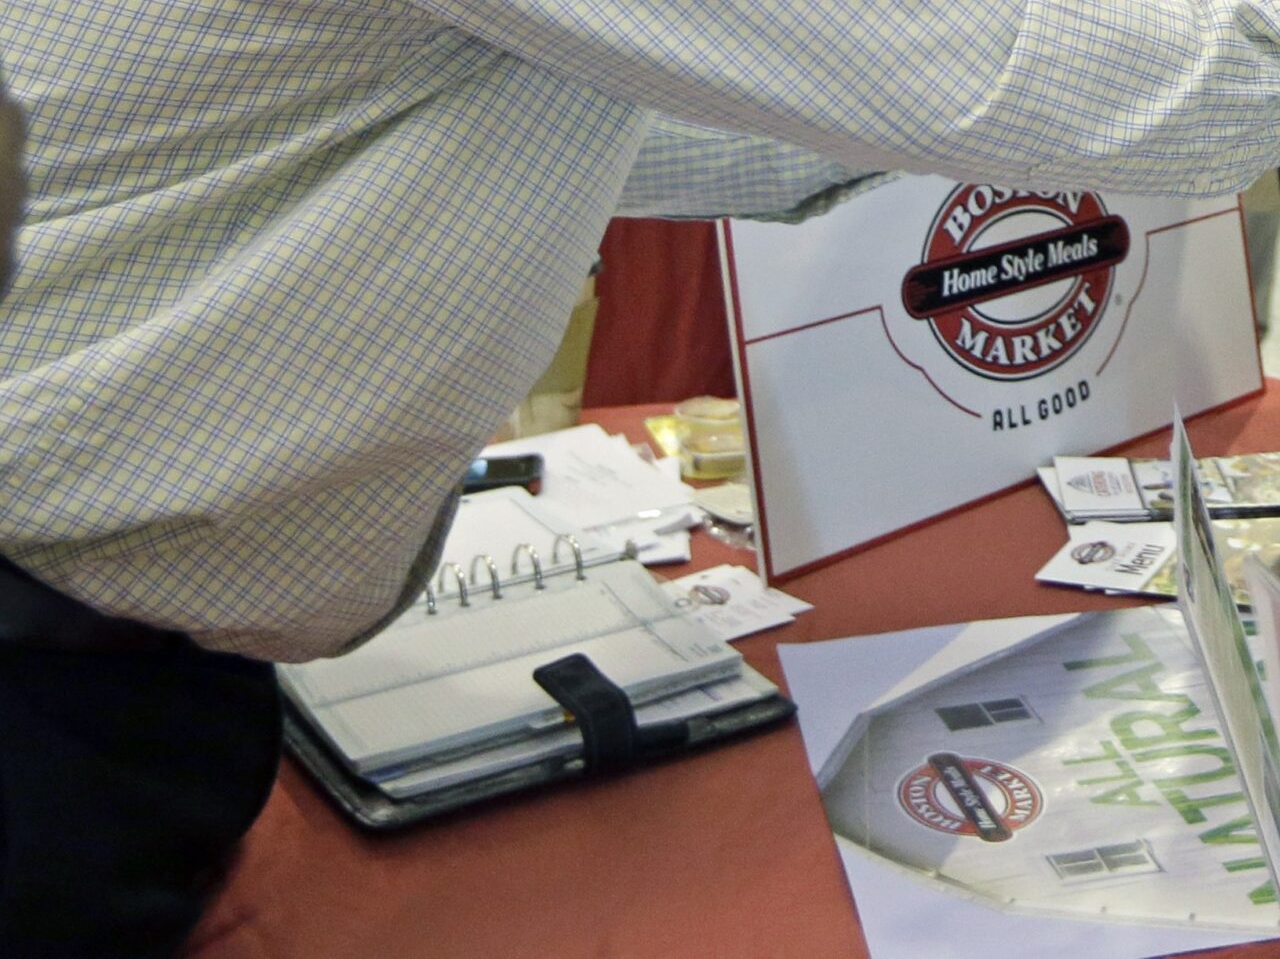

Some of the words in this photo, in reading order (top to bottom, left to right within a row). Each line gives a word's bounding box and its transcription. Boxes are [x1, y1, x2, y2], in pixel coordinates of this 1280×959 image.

[942, 264, 998, 297] Home
[1001, 248, 1045, 281] Style
[1047, 234, 1099, 268] Meals
[956, 282, 1096, 365] MARKET
[992, 406, 1032, 431] ALL
[1038, 379, 1091, 421] GOOD
[1114, 543, 1166, 576] Menu
